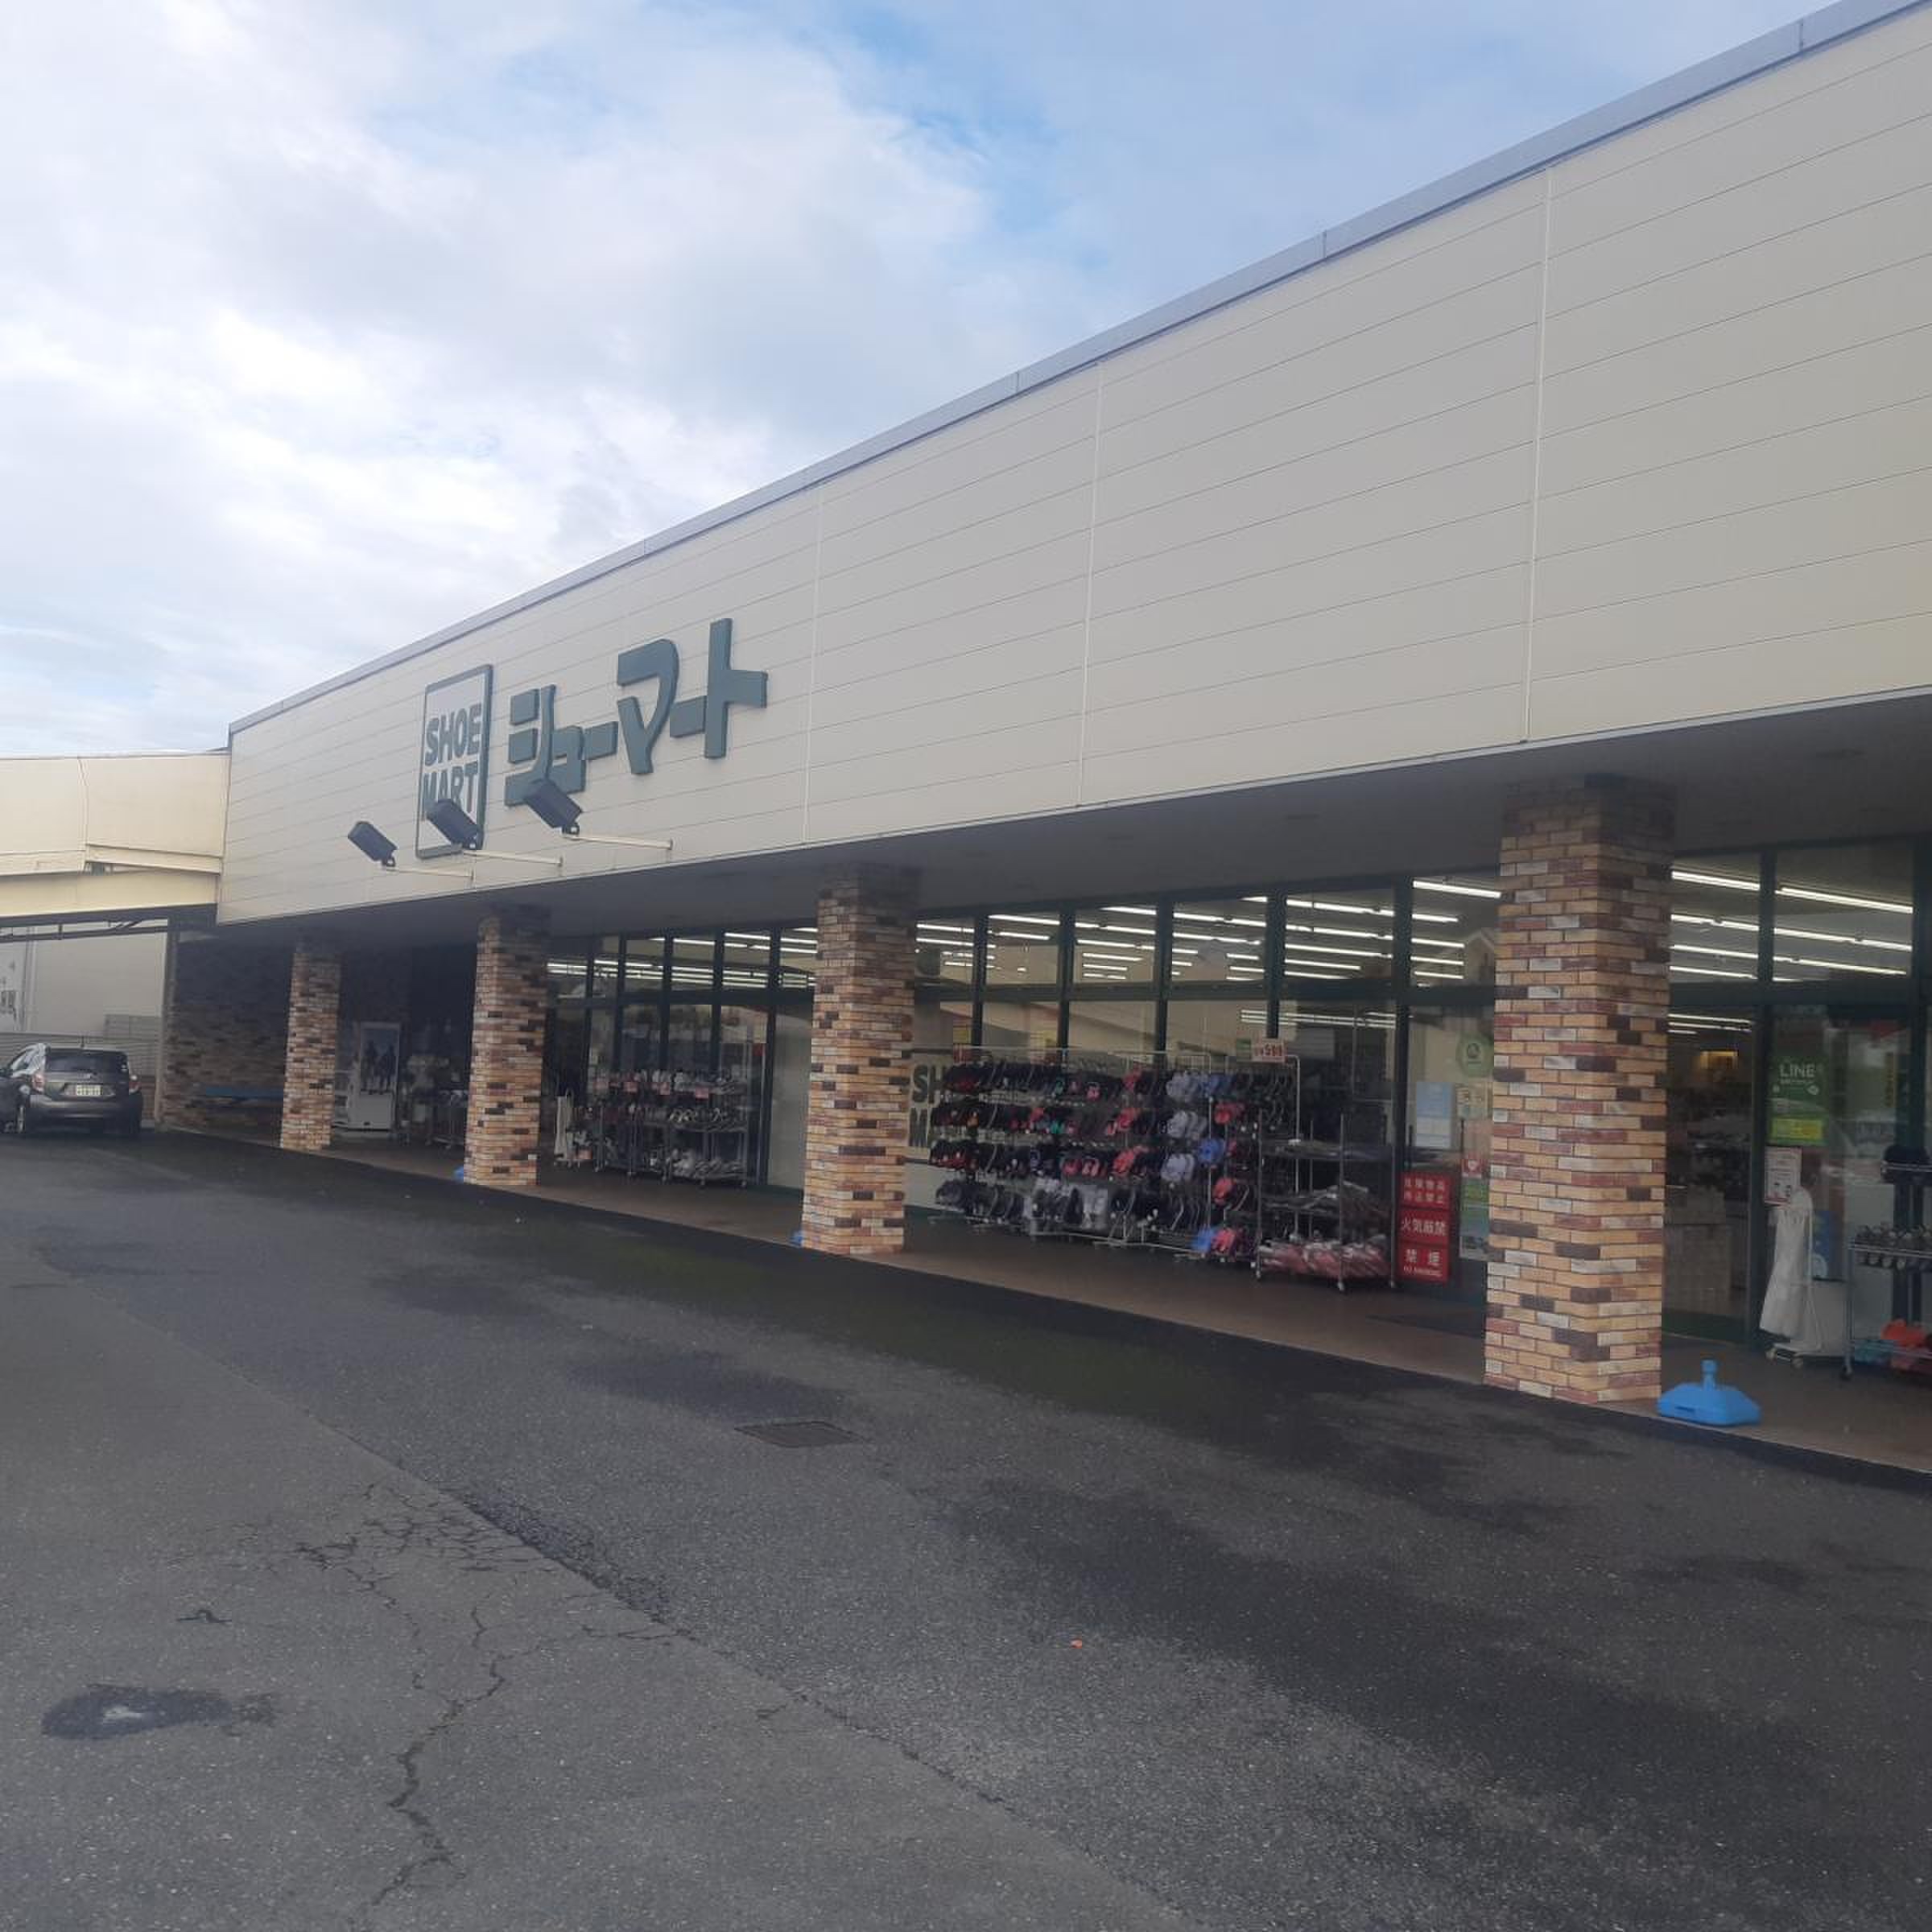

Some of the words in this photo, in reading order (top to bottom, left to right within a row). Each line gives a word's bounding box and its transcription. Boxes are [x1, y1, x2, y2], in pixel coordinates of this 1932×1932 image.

[424, 702, 482, 766] SHOE
[505, 617, 768, 807] シューマート
[1779, 1063, 1816, 1078] LINE
